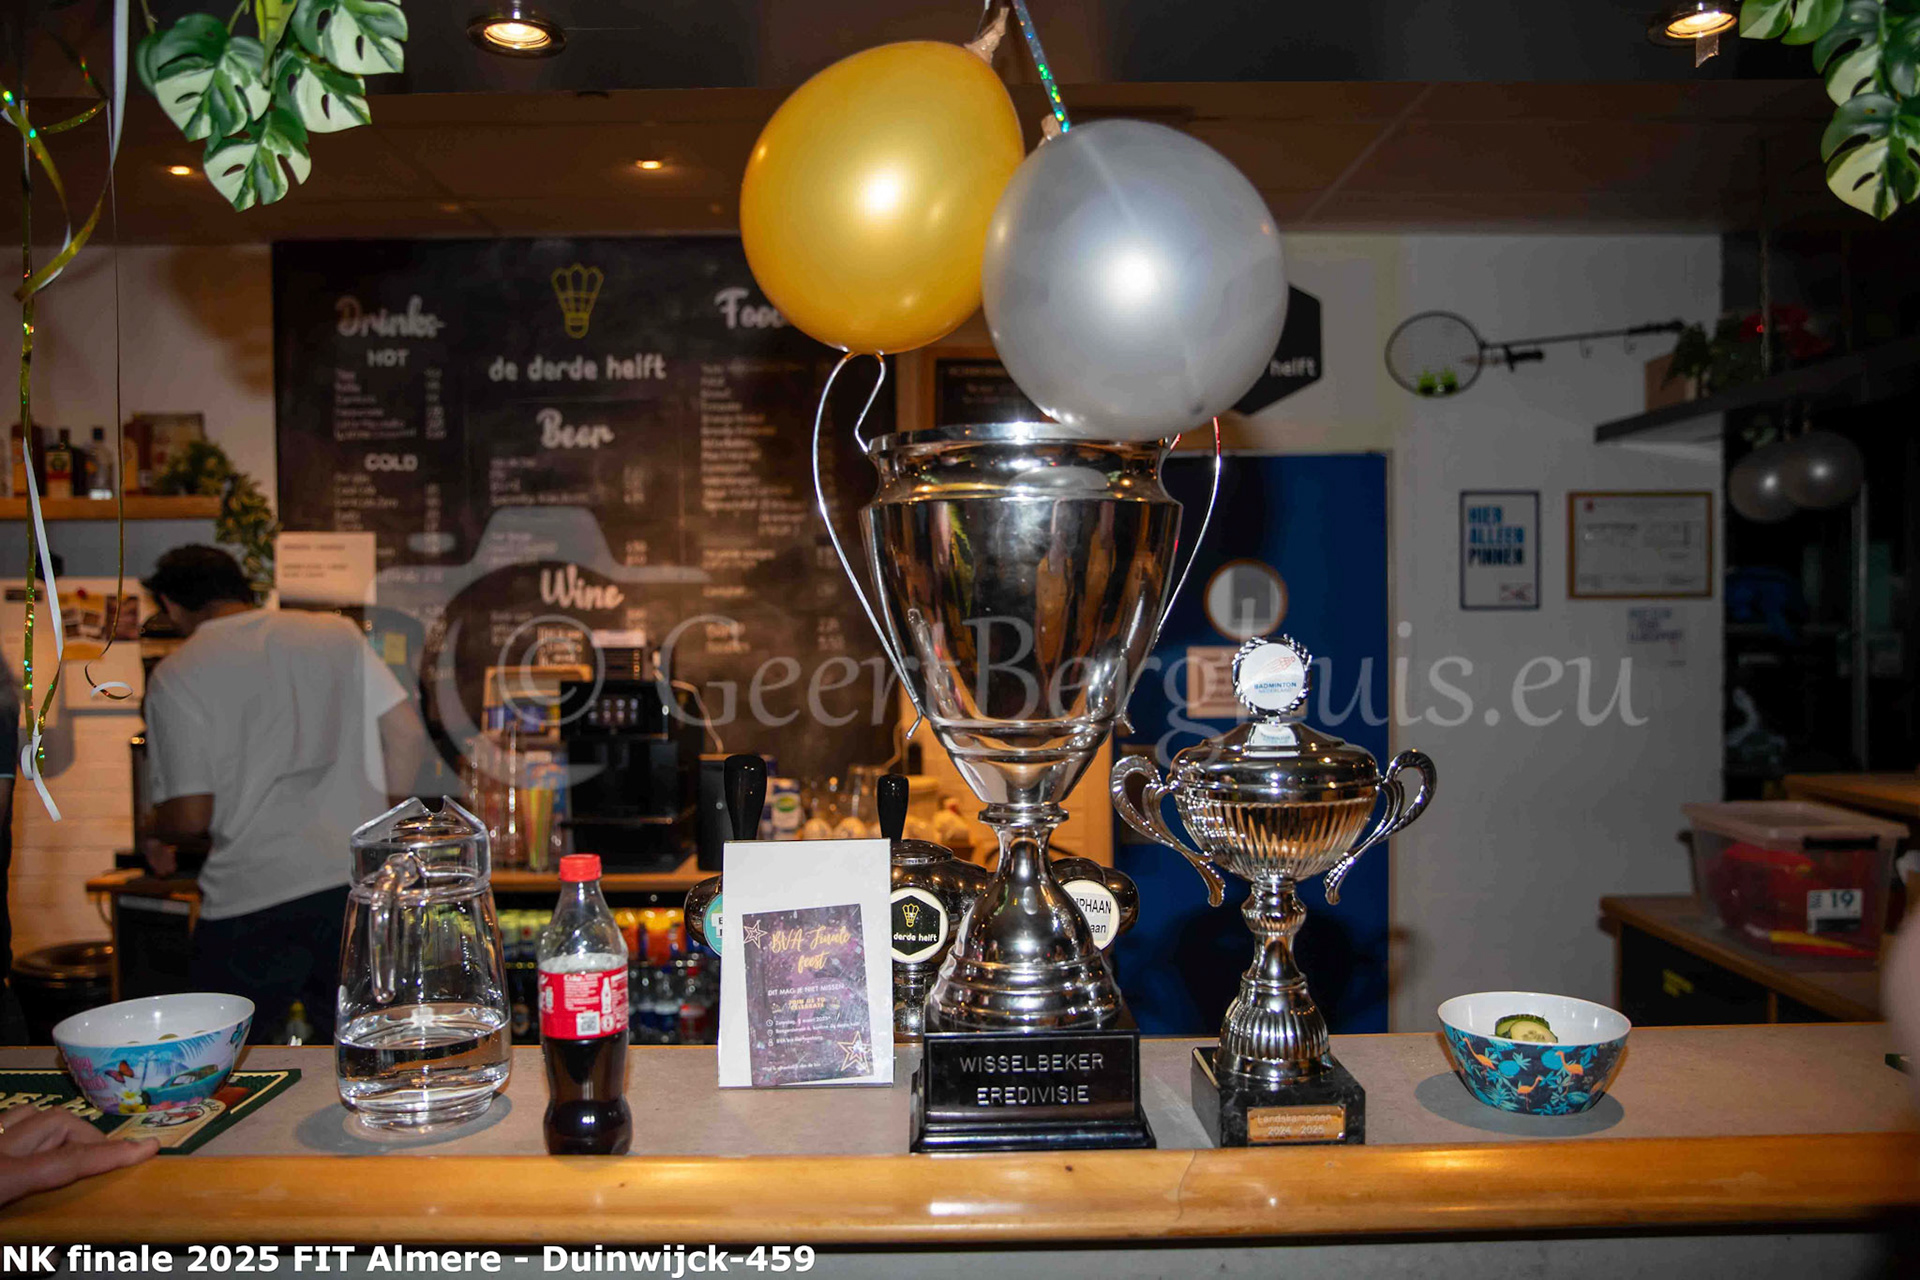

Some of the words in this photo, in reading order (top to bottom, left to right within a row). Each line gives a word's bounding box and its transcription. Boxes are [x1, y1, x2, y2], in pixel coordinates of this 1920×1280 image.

[335, 293, 446, 339] Drinks
[366, 347, 410, 368] HOT
[488, 354, 518, 382] de
[526, 354, 599, 382] derde
[605, 353, 667, 380] helft
[1268, 355, 1318, 379] helft
[535, 407, 615, 451] Beer
[363, 452, 420, 472] COLD
[1467, 506, 1503, 525] HIER
[1468, 526, 1525, 546] ALLEEN
[1467, 546, 1524, 567] PINNEN
[540, 563, 625, 611] Wine
[1832, 891, 1854, 908] 19
[893, 932, 916, 942] derde
[918, 933, 938, 942] helft
[798, 951, 830, 974] feest
[767, 989, 778, 997] DIT
[779, 987, 796, 996] MAG
[796, 987, 804, 995] JE
[804, 985, 819, 994] NIET
[959, 1052, 1104, 1074] WISSELBEKER
[976, 1084, 1090, 1106] EREDIVISIE
[1256, 1113, 1333, 1125] Landskampioen
[1267, 1125, 1292, 1136] 2024
[1300, 1124, 1326, 1135] 2025
